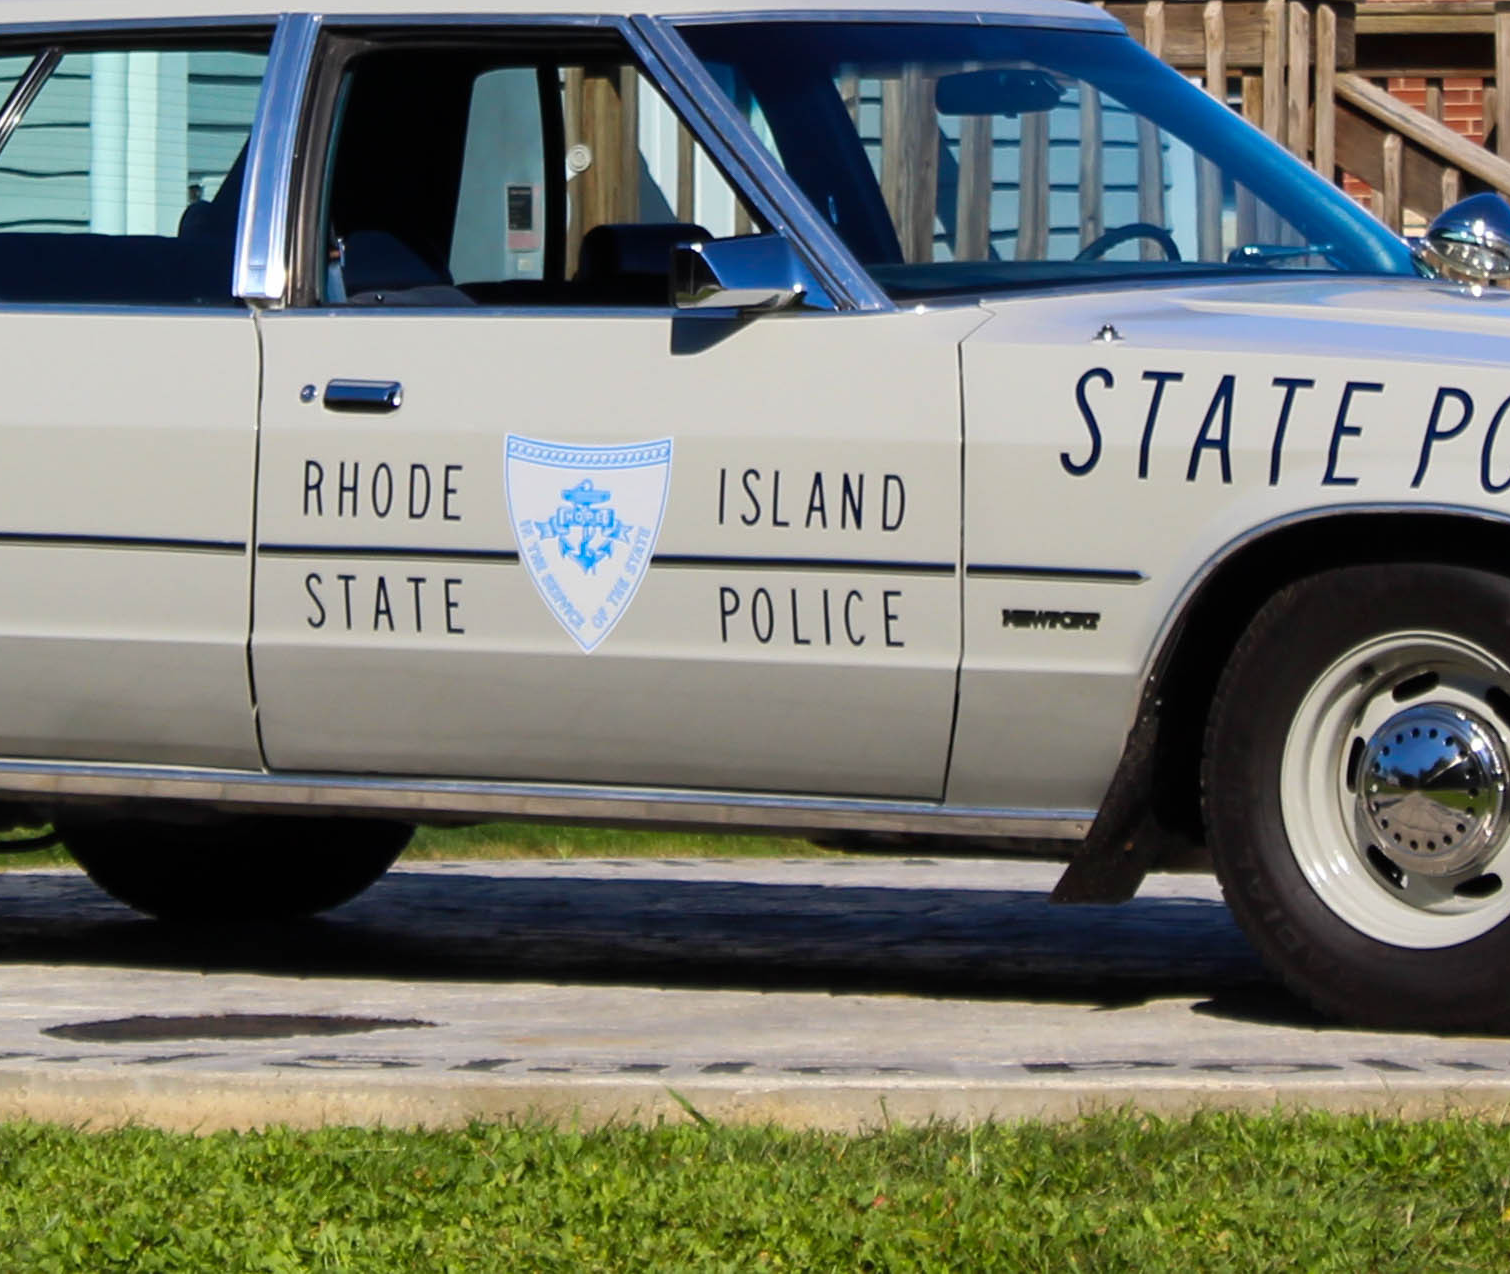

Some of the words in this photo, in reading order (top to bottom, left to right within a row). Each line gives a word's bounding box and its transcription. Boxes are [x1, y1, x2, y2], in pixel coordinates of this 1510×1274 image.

[1060, 367, 1384, 486] STATE
[303, 460, 463, 521] RHODE
[718, 468, 906, 531] ISLAND
[305, 572, 465, 634] STATE
[719, 586, 905, 647] POLICE
